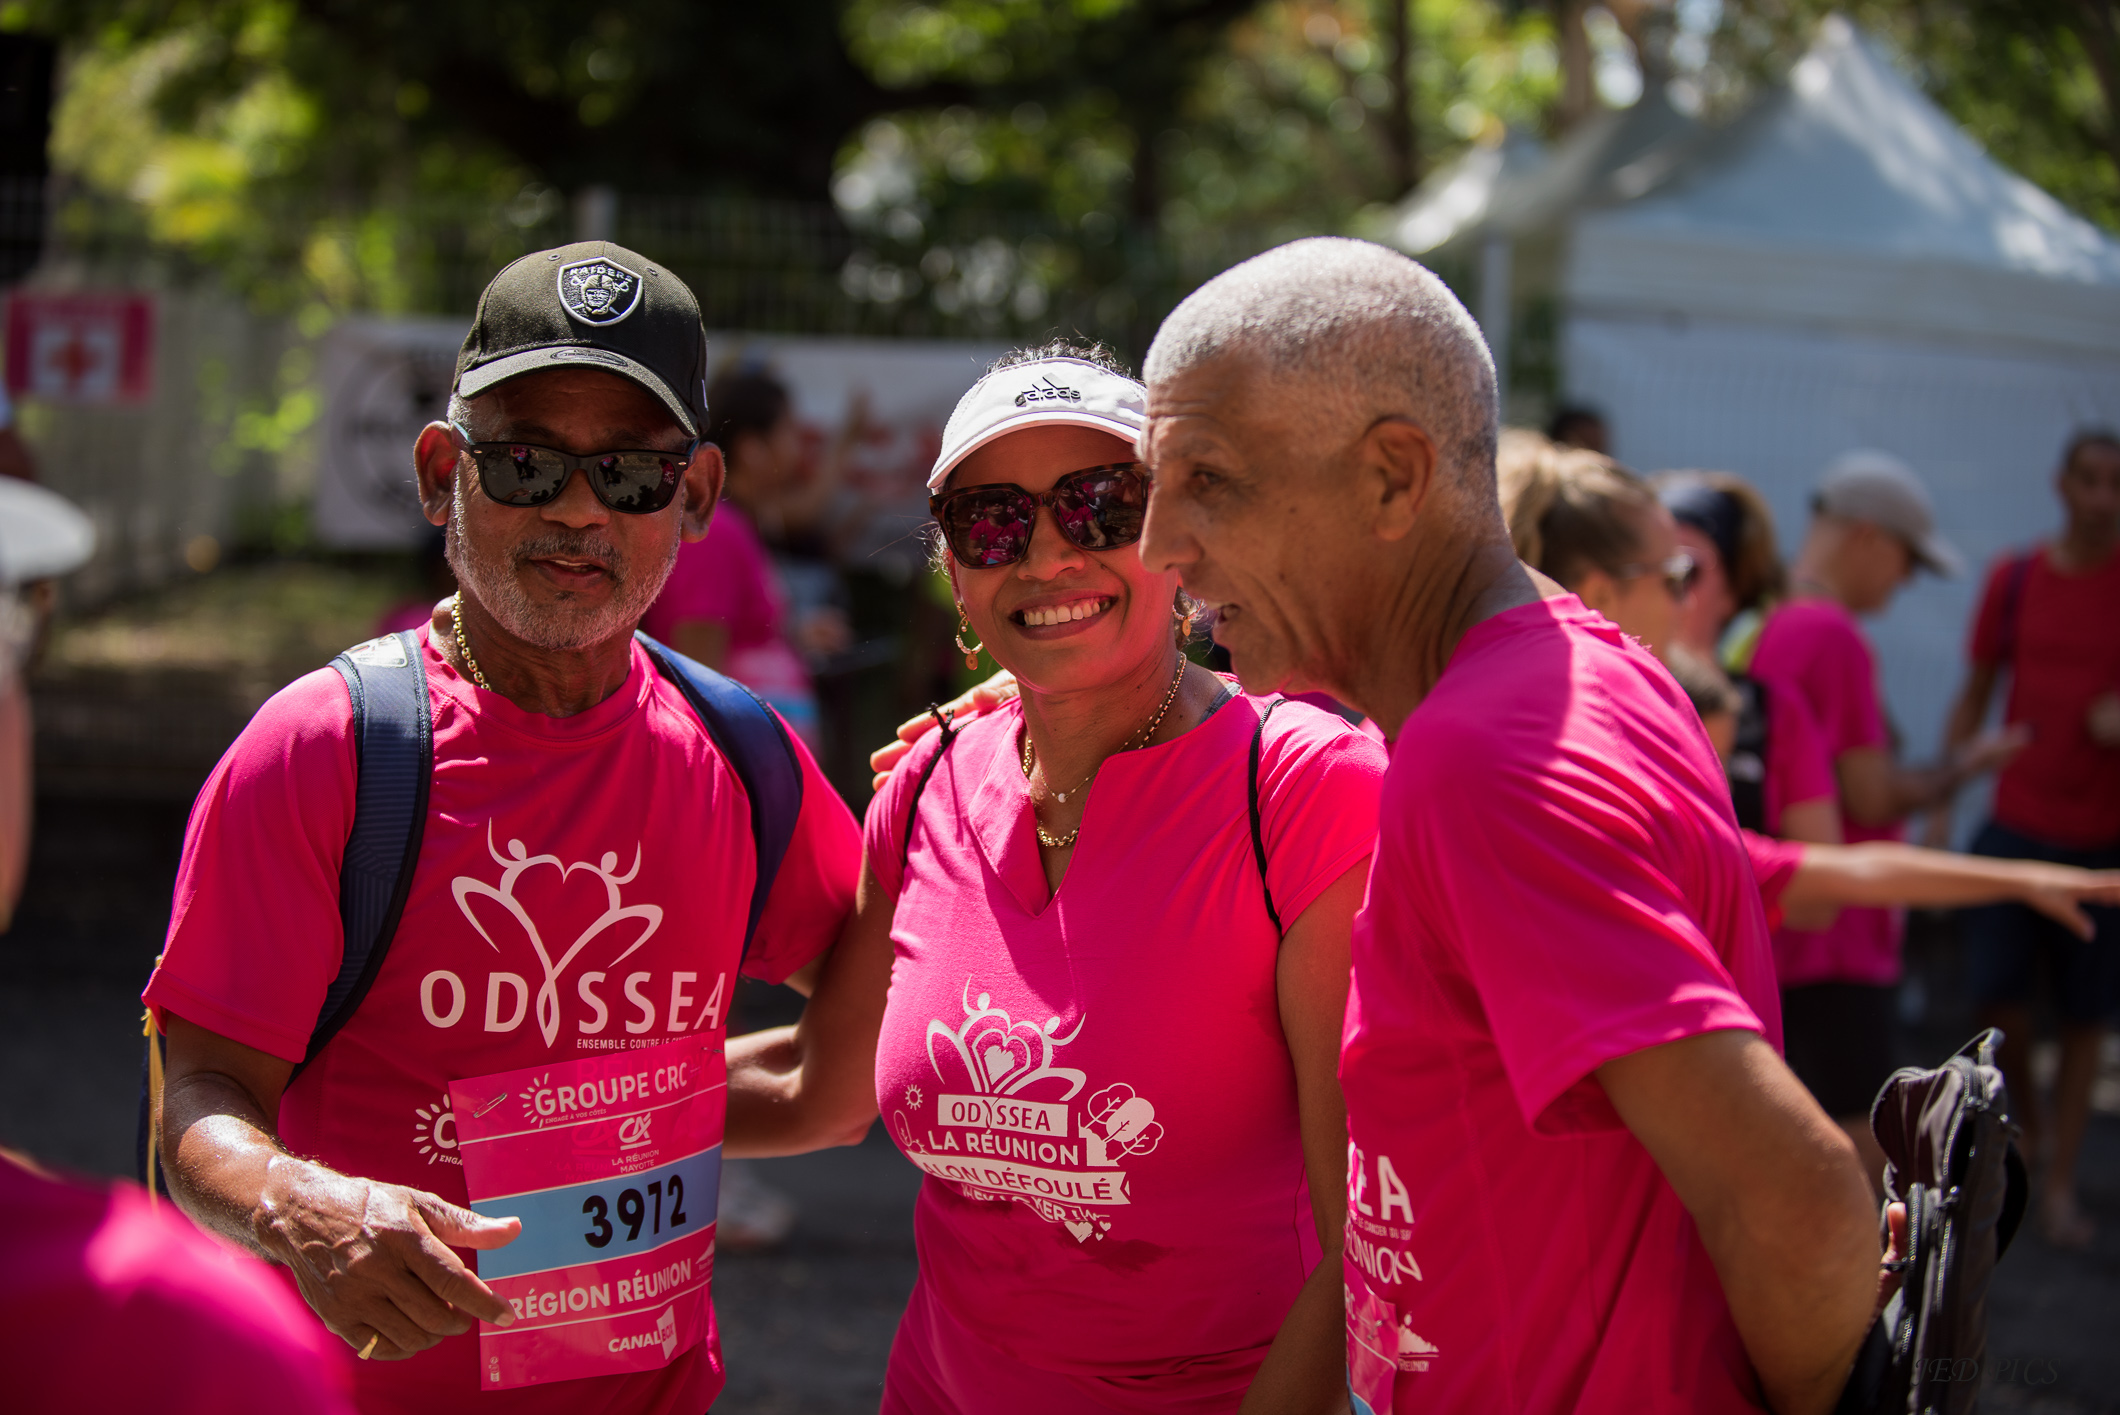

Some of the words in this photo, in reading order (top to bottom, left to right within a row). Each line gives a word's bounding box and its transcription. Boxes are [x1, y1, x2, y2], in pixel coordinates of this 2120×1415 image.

[569, 265, 633, 283] RAIDERS
[1014, 387, 1082, 407] adidas
[420, 970, 727, 1048] ODYSSEA
[577, 1038, 626, 1049] ENSEMBLE
[630, 1038, 659, 1049] CONTRE
[535, 1071, 650, 1116] GROUPE
[654, 1062, 687, 1094] CRC
[951, 1099, 1051, 1132] ODYSSEA
[612, 1157, 623, 1166] LA
[626, 1149, 660, 1162] RÉUNION
[928, 1130, 960, 1151] LA
[966, 1130, 1078, 1166] RÉUNION
[620, 1160, 655, 1173] MAYOTTE
[984, 1167, 1113, 1200] DÉFOULÉ
[582, 1174, 687, 1249] 3972
[509, 1288, 611, 1320] RÉGION
[617, 1258, 692, 1304] RÉUNION
